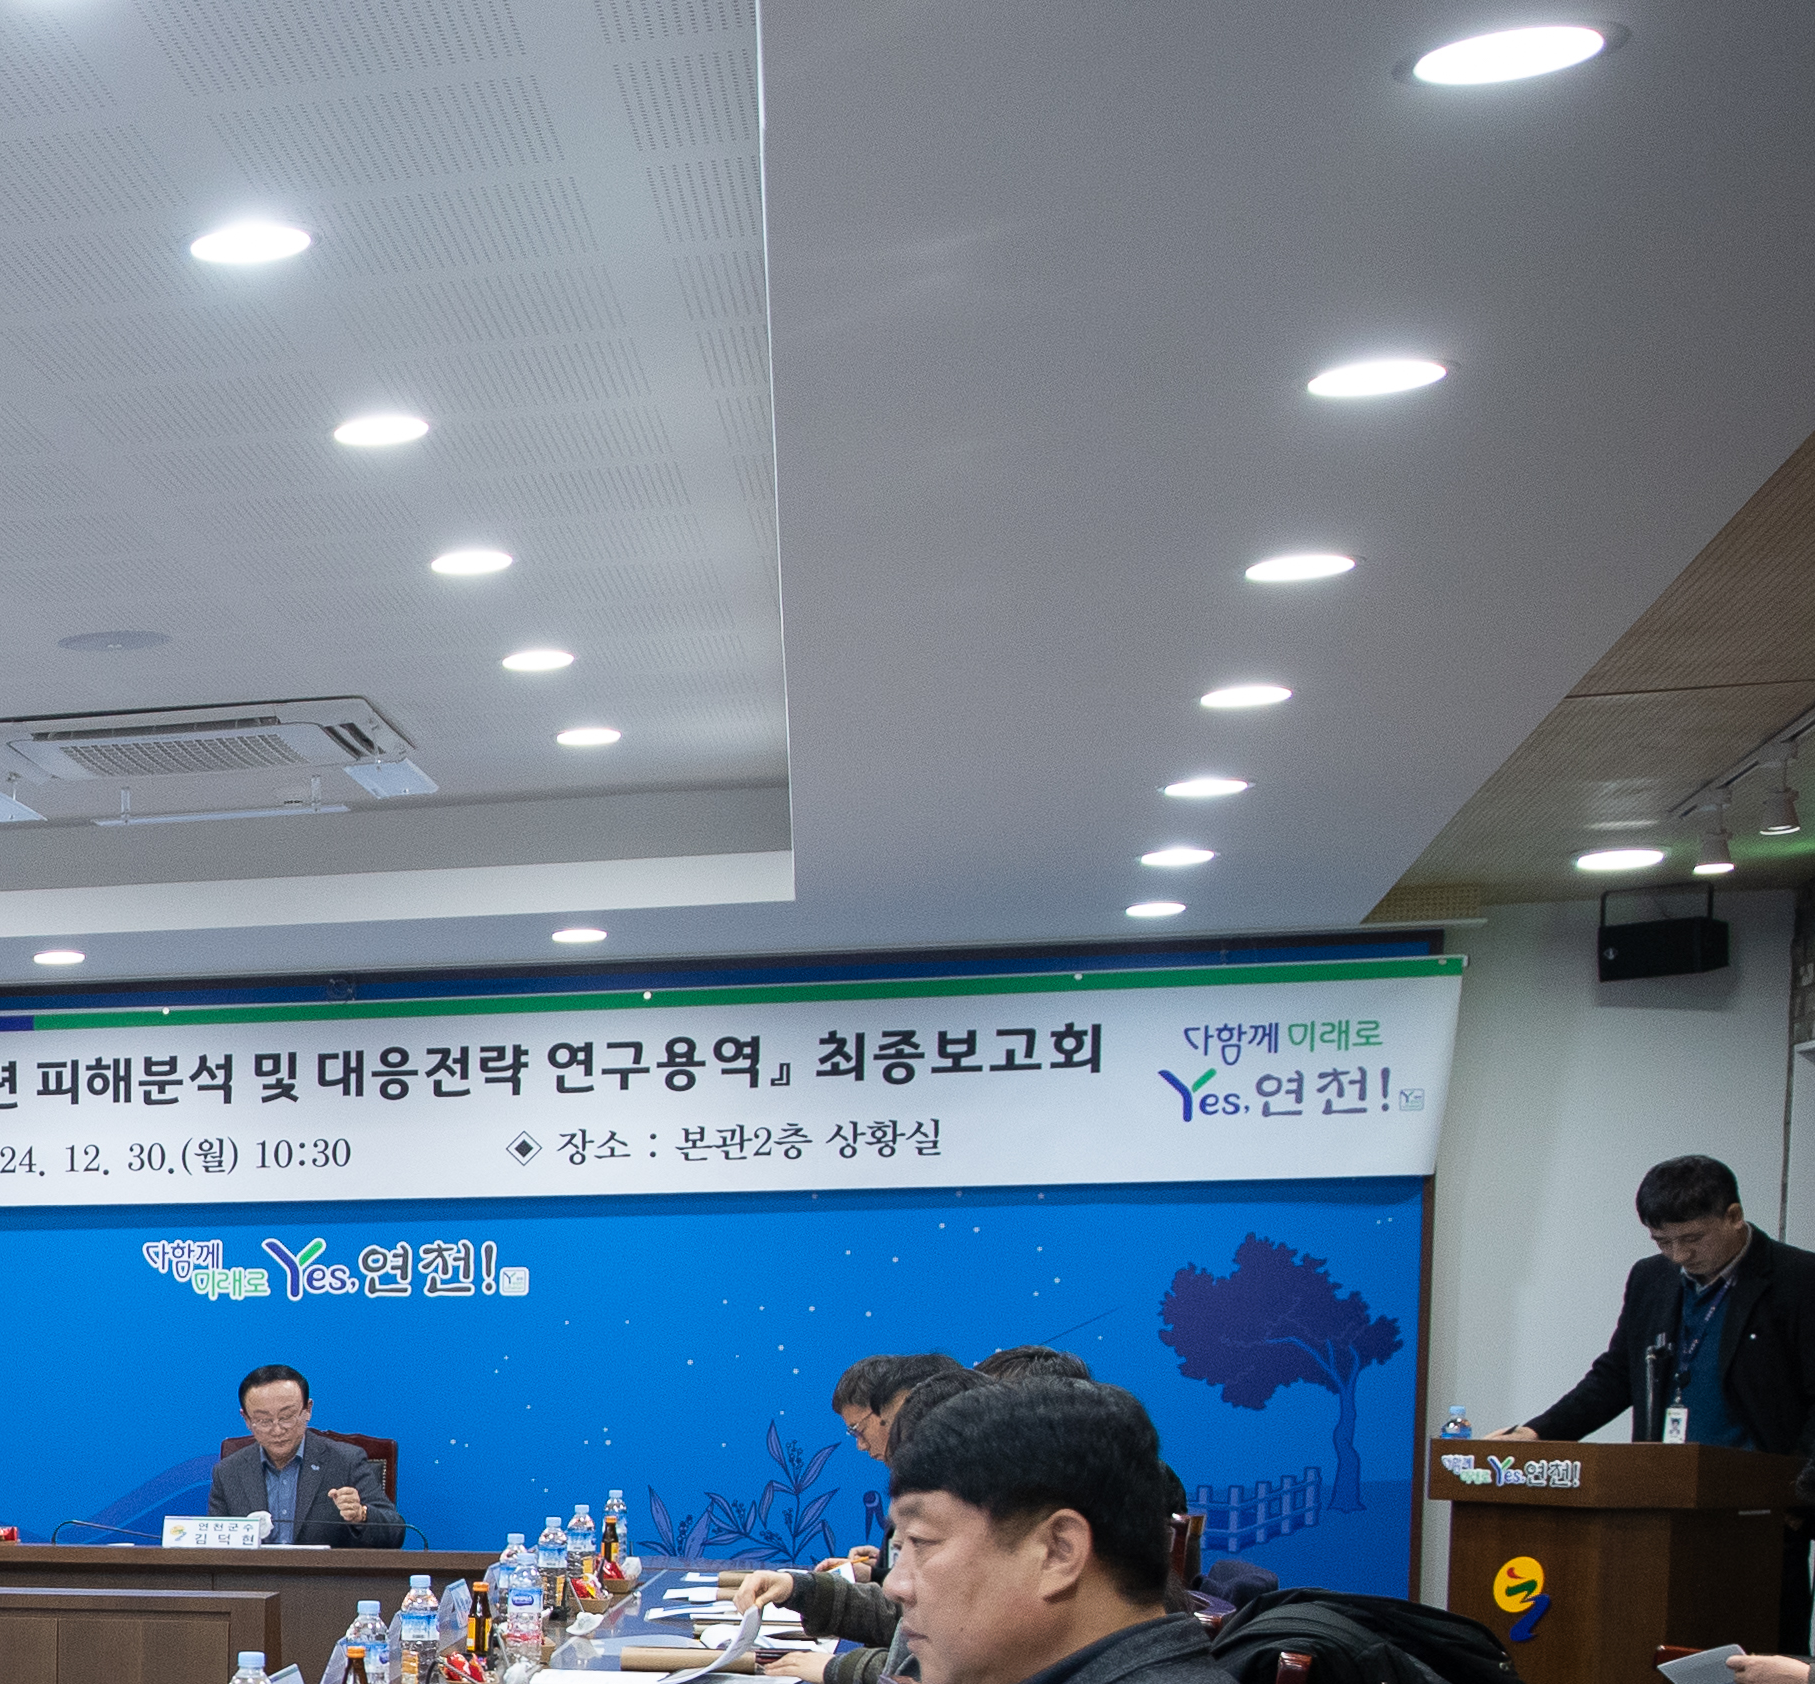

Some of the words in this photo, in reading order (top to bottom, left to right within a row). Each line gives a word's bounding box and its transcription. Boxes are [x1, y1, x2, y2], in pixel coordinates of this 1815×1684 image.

[36, 1052, 234, 1106] 피해분석
[254, 1050, 299, 1104] 및
[317, 1043, 530, 1101] 대응전략
[547, 1033, 792, 1094] 연구용역』
[815, 1021, 1103, 1086] 최종보고회
[1183, 1021, 1280, 1067] 다함께
[1287, 1018, 1383, 1053] 미래로
[1158, 1066, 1250, 1123] Yes,
[1255, 1065, 1392, 1118] 연천!
[63, 1144, 110, 1176] 12.
[127, 1137, 239, 1175] 30.(월)
[255, 1138, 352, 1169] 10:30
[557, 1128, 631, 1166] 장소
[676, 1122, 813, 1162] 본관2층
[826, 1118, 941, 1159] 상황실
[144, 1239, 223, 1281] 다함께
[359, 1240, 496, 1297] 연천!
[194, 1269, 269, 1300] 미래로
